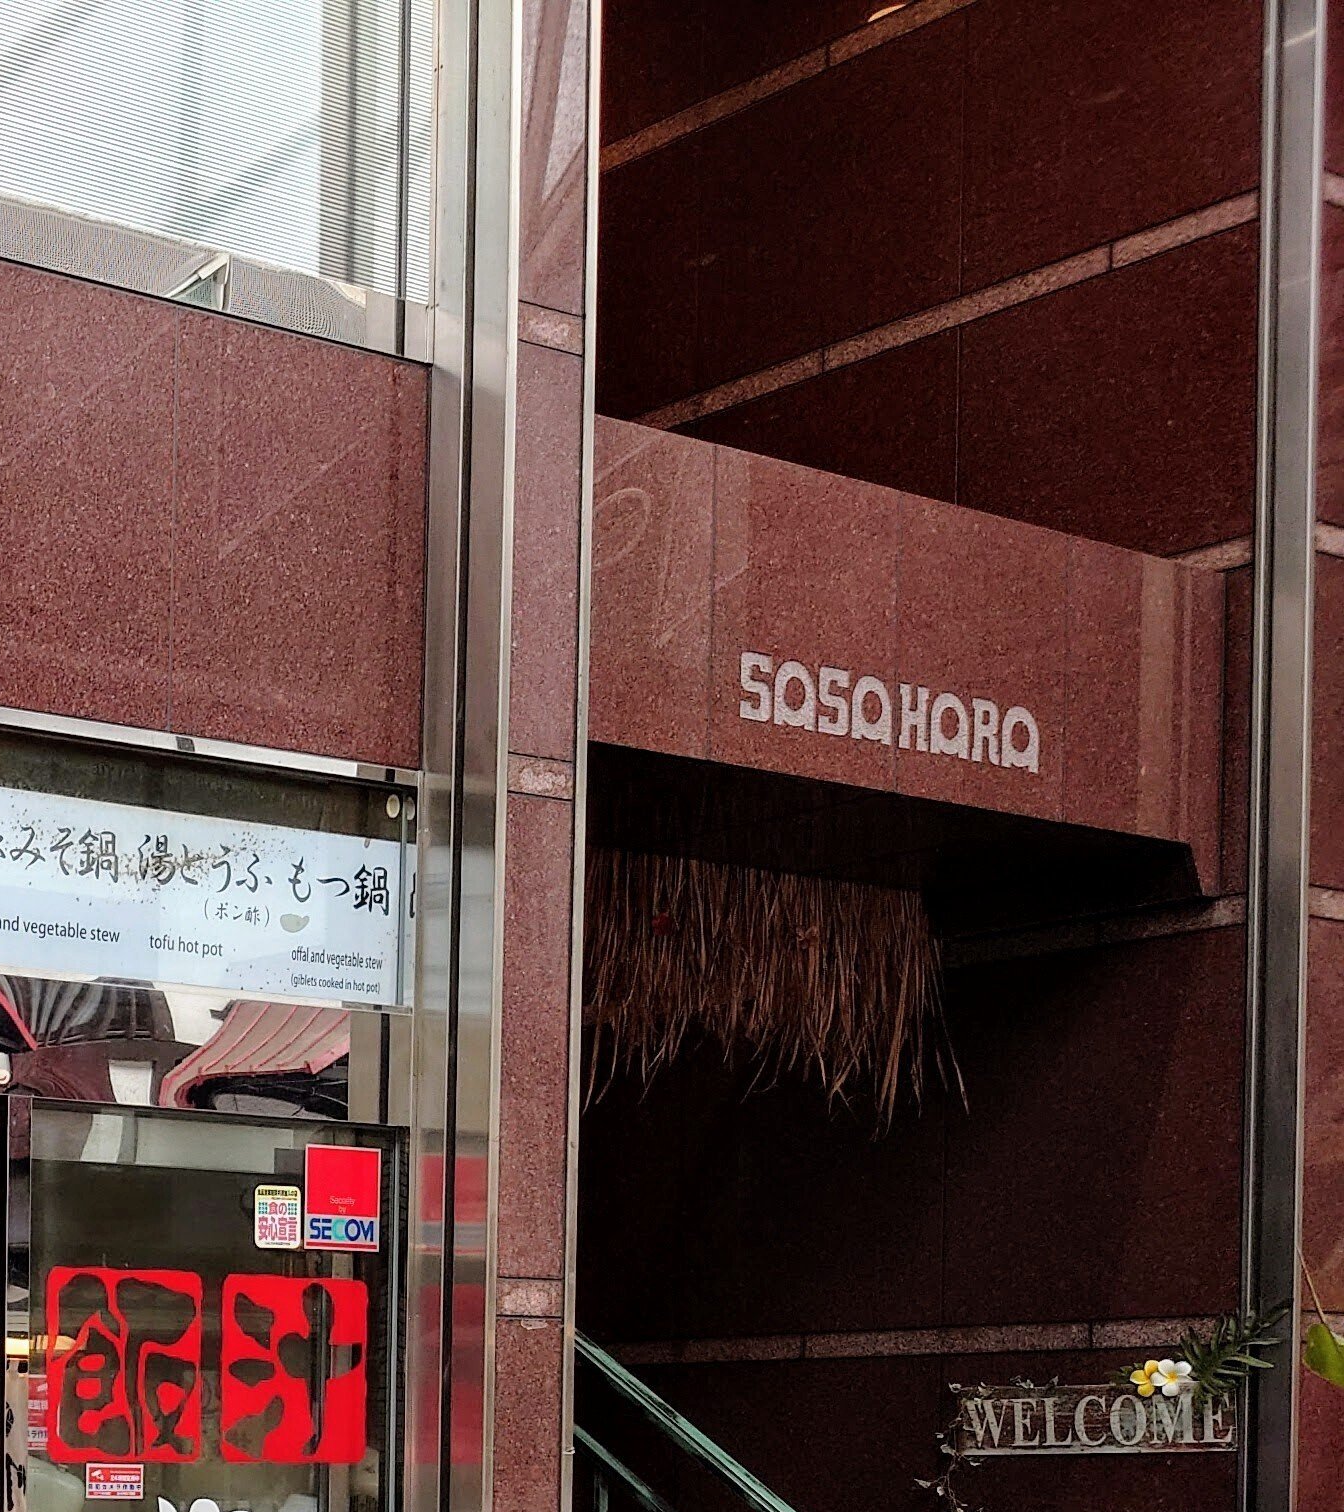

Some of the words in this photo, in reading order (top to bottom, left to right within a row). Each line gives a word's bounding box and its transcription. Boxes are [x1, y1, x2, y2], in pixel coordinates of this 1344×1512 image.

[287, 856, 390, 917] もつ鍋
[23, 917, 87, 943] vegetable
[89, 926, 120, 944] stew
[149, 934, 175, 951] tofu
[177, 937, 198, 954] hot
[201, 940, 224, 959] pot
[290, 946, 309, 964] offal
[310, 952, 326, 966] and
[327, 953, 363, 969] vegetable
[365, 955, 383, 971] stew
[309, 1218, 374, 1242] SECOM
[221, 1274, 366, 1462] 汁
[960, 1388, 1236, 1452] WELCOME
